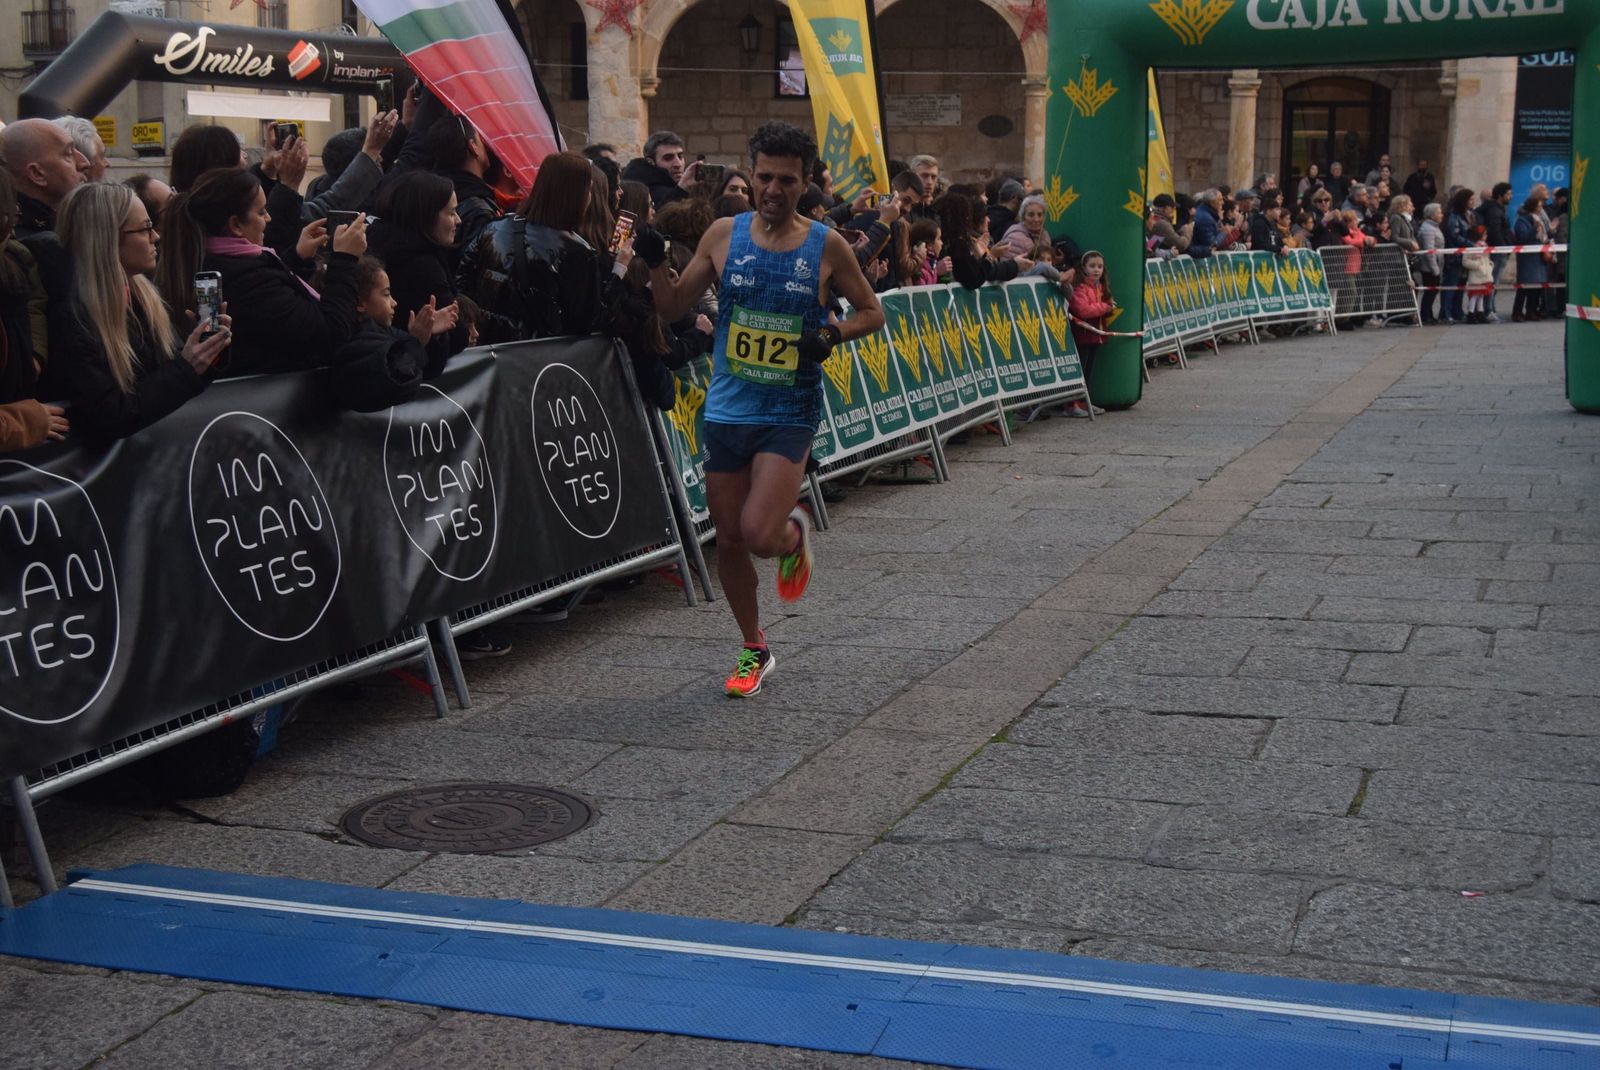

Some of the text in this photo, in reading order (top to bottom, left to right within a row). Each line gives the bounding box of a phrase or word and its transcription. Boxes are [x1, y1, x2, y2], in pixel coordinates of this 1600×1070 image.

[153, 26, 276, 78] Smiles
[333, 49, 344, 61] by
[132, 126, 148, 137] ORO
[1530, 164, 1565, 182] 016
[749, 321, 792, 332] CAJA RURAL
[736, 331, 788, 365] 612
[742, 368, 791, 380] CAJA RURAL
[547, 396, 587, 428] IM
[834, 406, 870, 428] CAJA RURAL
[873, 400, 888, 415] CAJA
[886, 394, 905, 411] RURAL
[409, 418, 456, 457] IM
[543, 430, 610, 471] PLAN
[217, 453, 282, 498] IM
[397, 457, 484, 508] PLAN
[564, 471, 610, 507] TES
[206, 495, 323, 557] PLAN
[425, 504, 483, 545] TES
[239, 550, 316, 601] TES
[0, 615, 96, 677] TES
